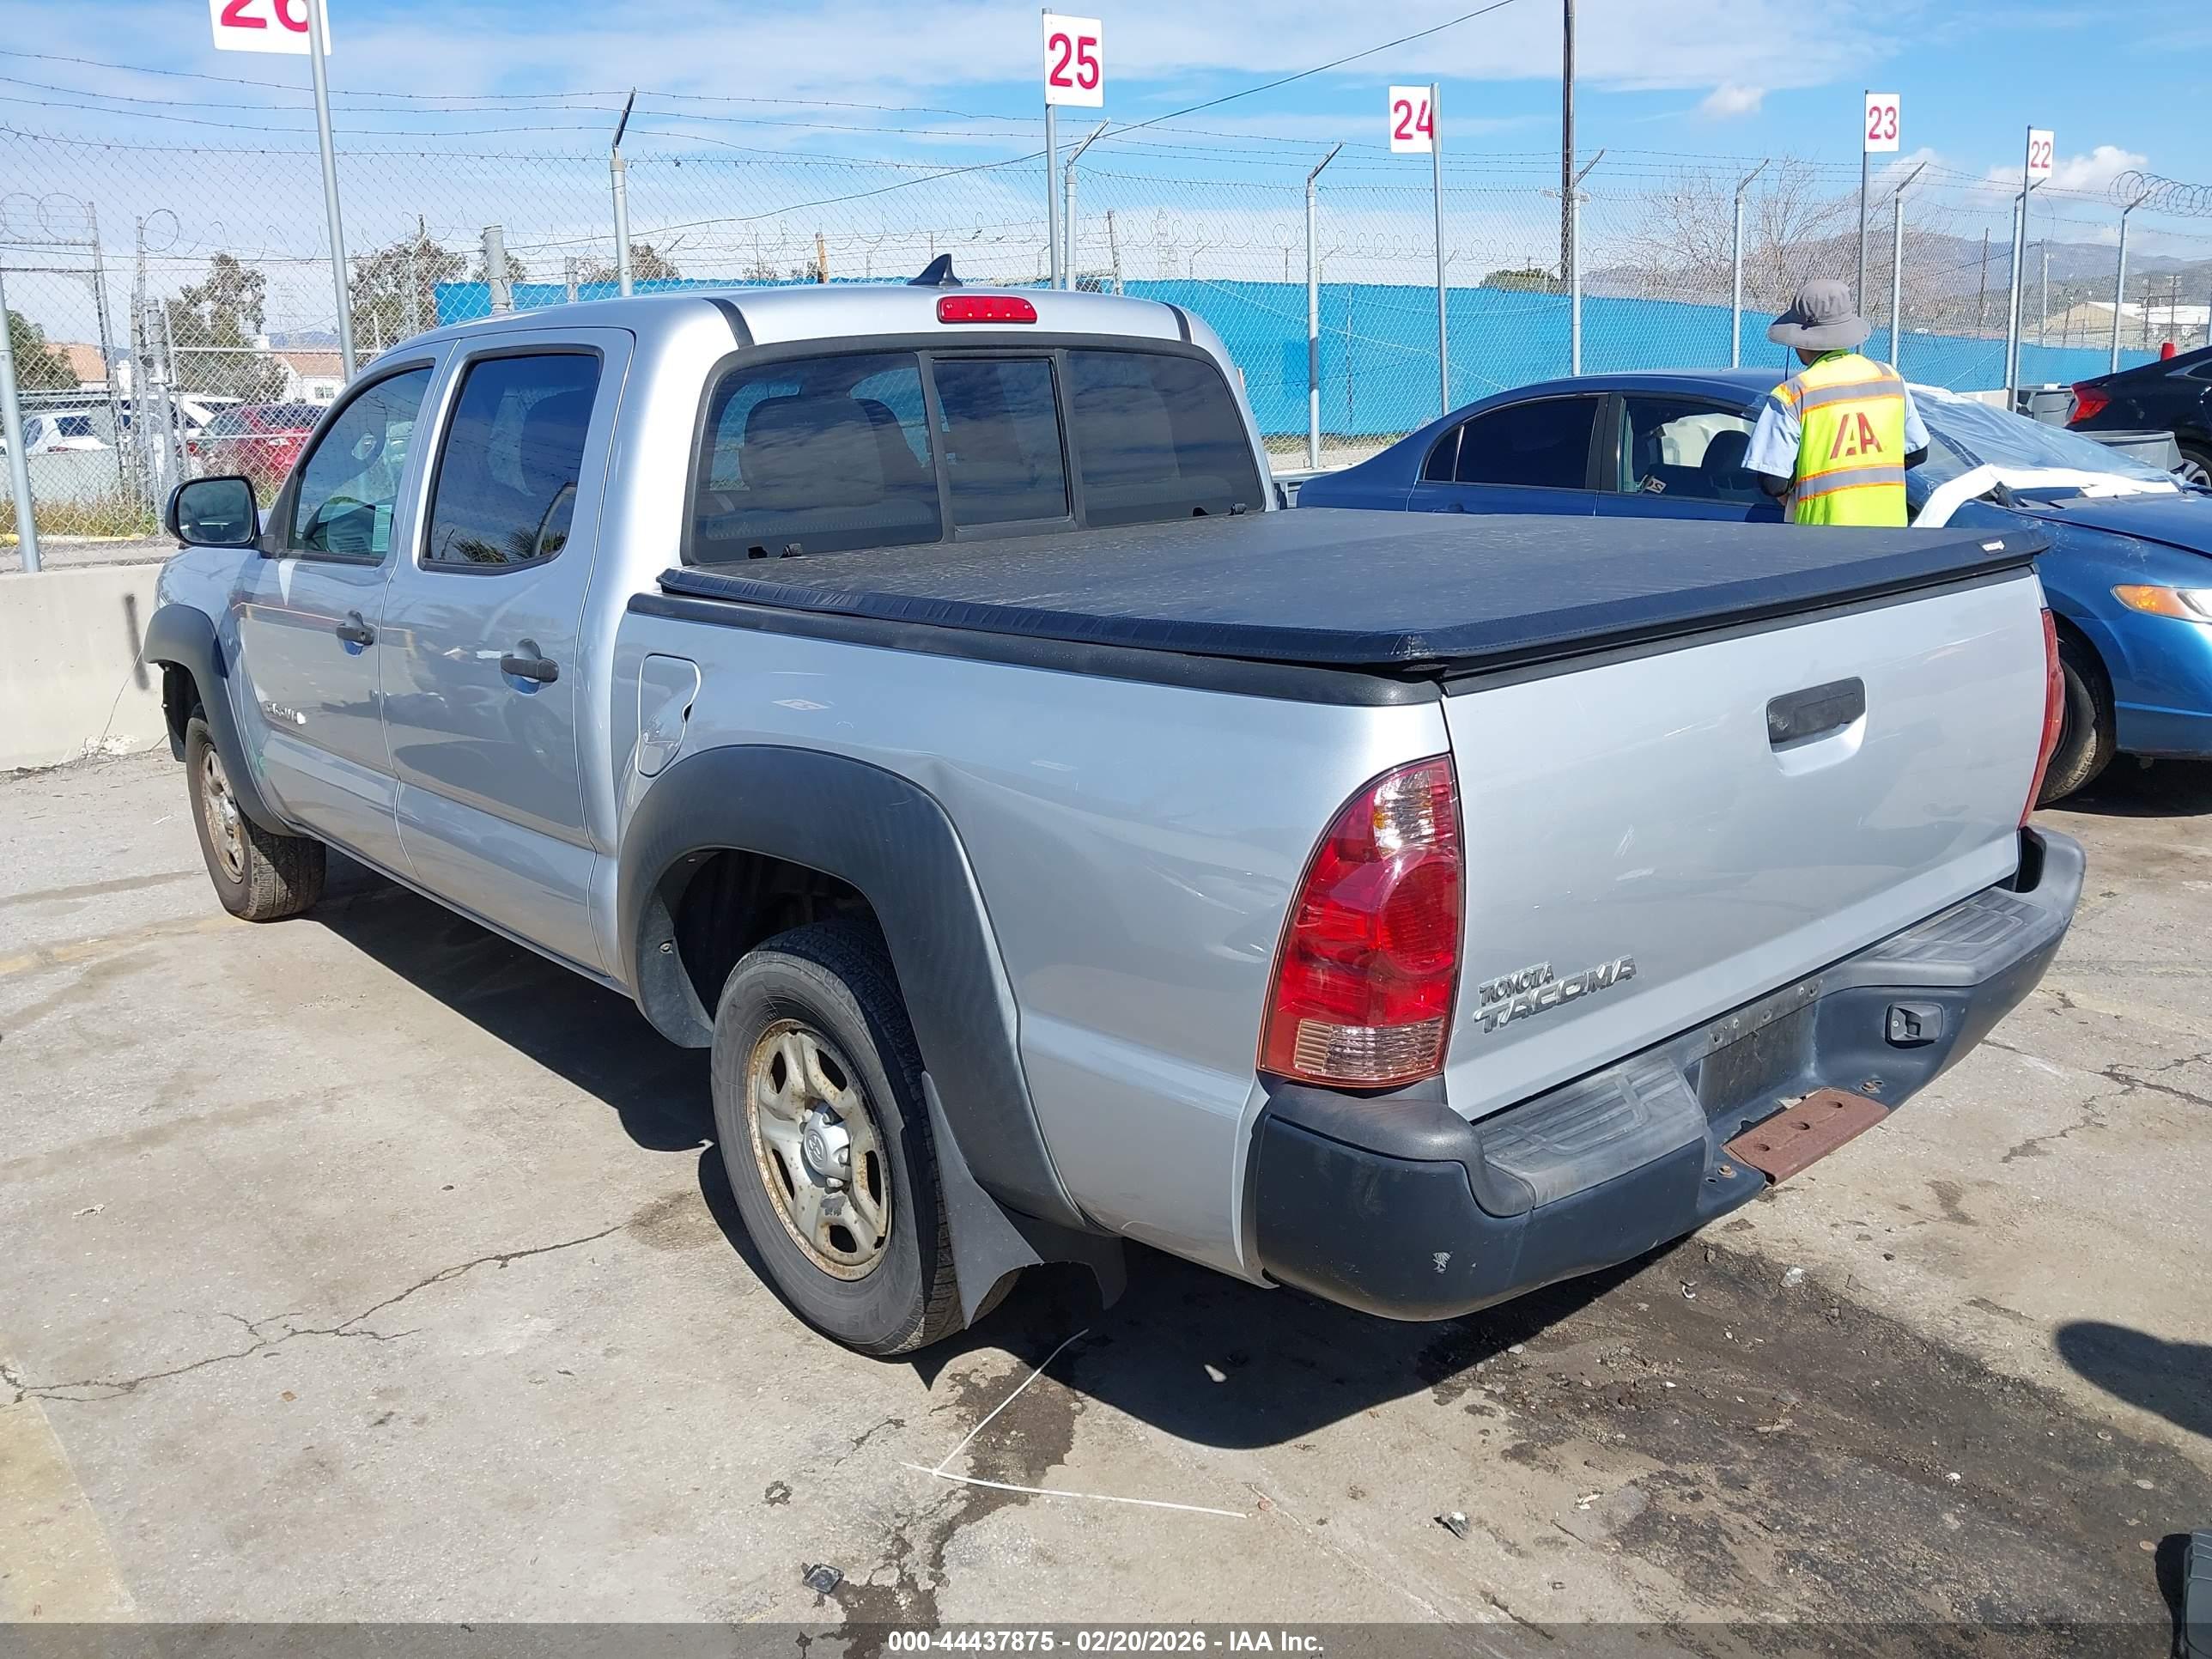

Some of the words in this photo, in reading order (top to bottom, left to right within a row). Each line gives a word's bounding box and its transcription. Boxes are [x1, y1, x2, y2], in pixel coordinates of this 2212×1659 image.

[1049, 33, 1099, 89] 25
[1394, 100, 1433, 140] 24
[1869, 106, 1897, 139] 23
[2030, 140, 2051, 168] 22
[1474, 955, 1637, 1034] TACOMA
[1479, 961, 1554, 1006] TOYOTA
